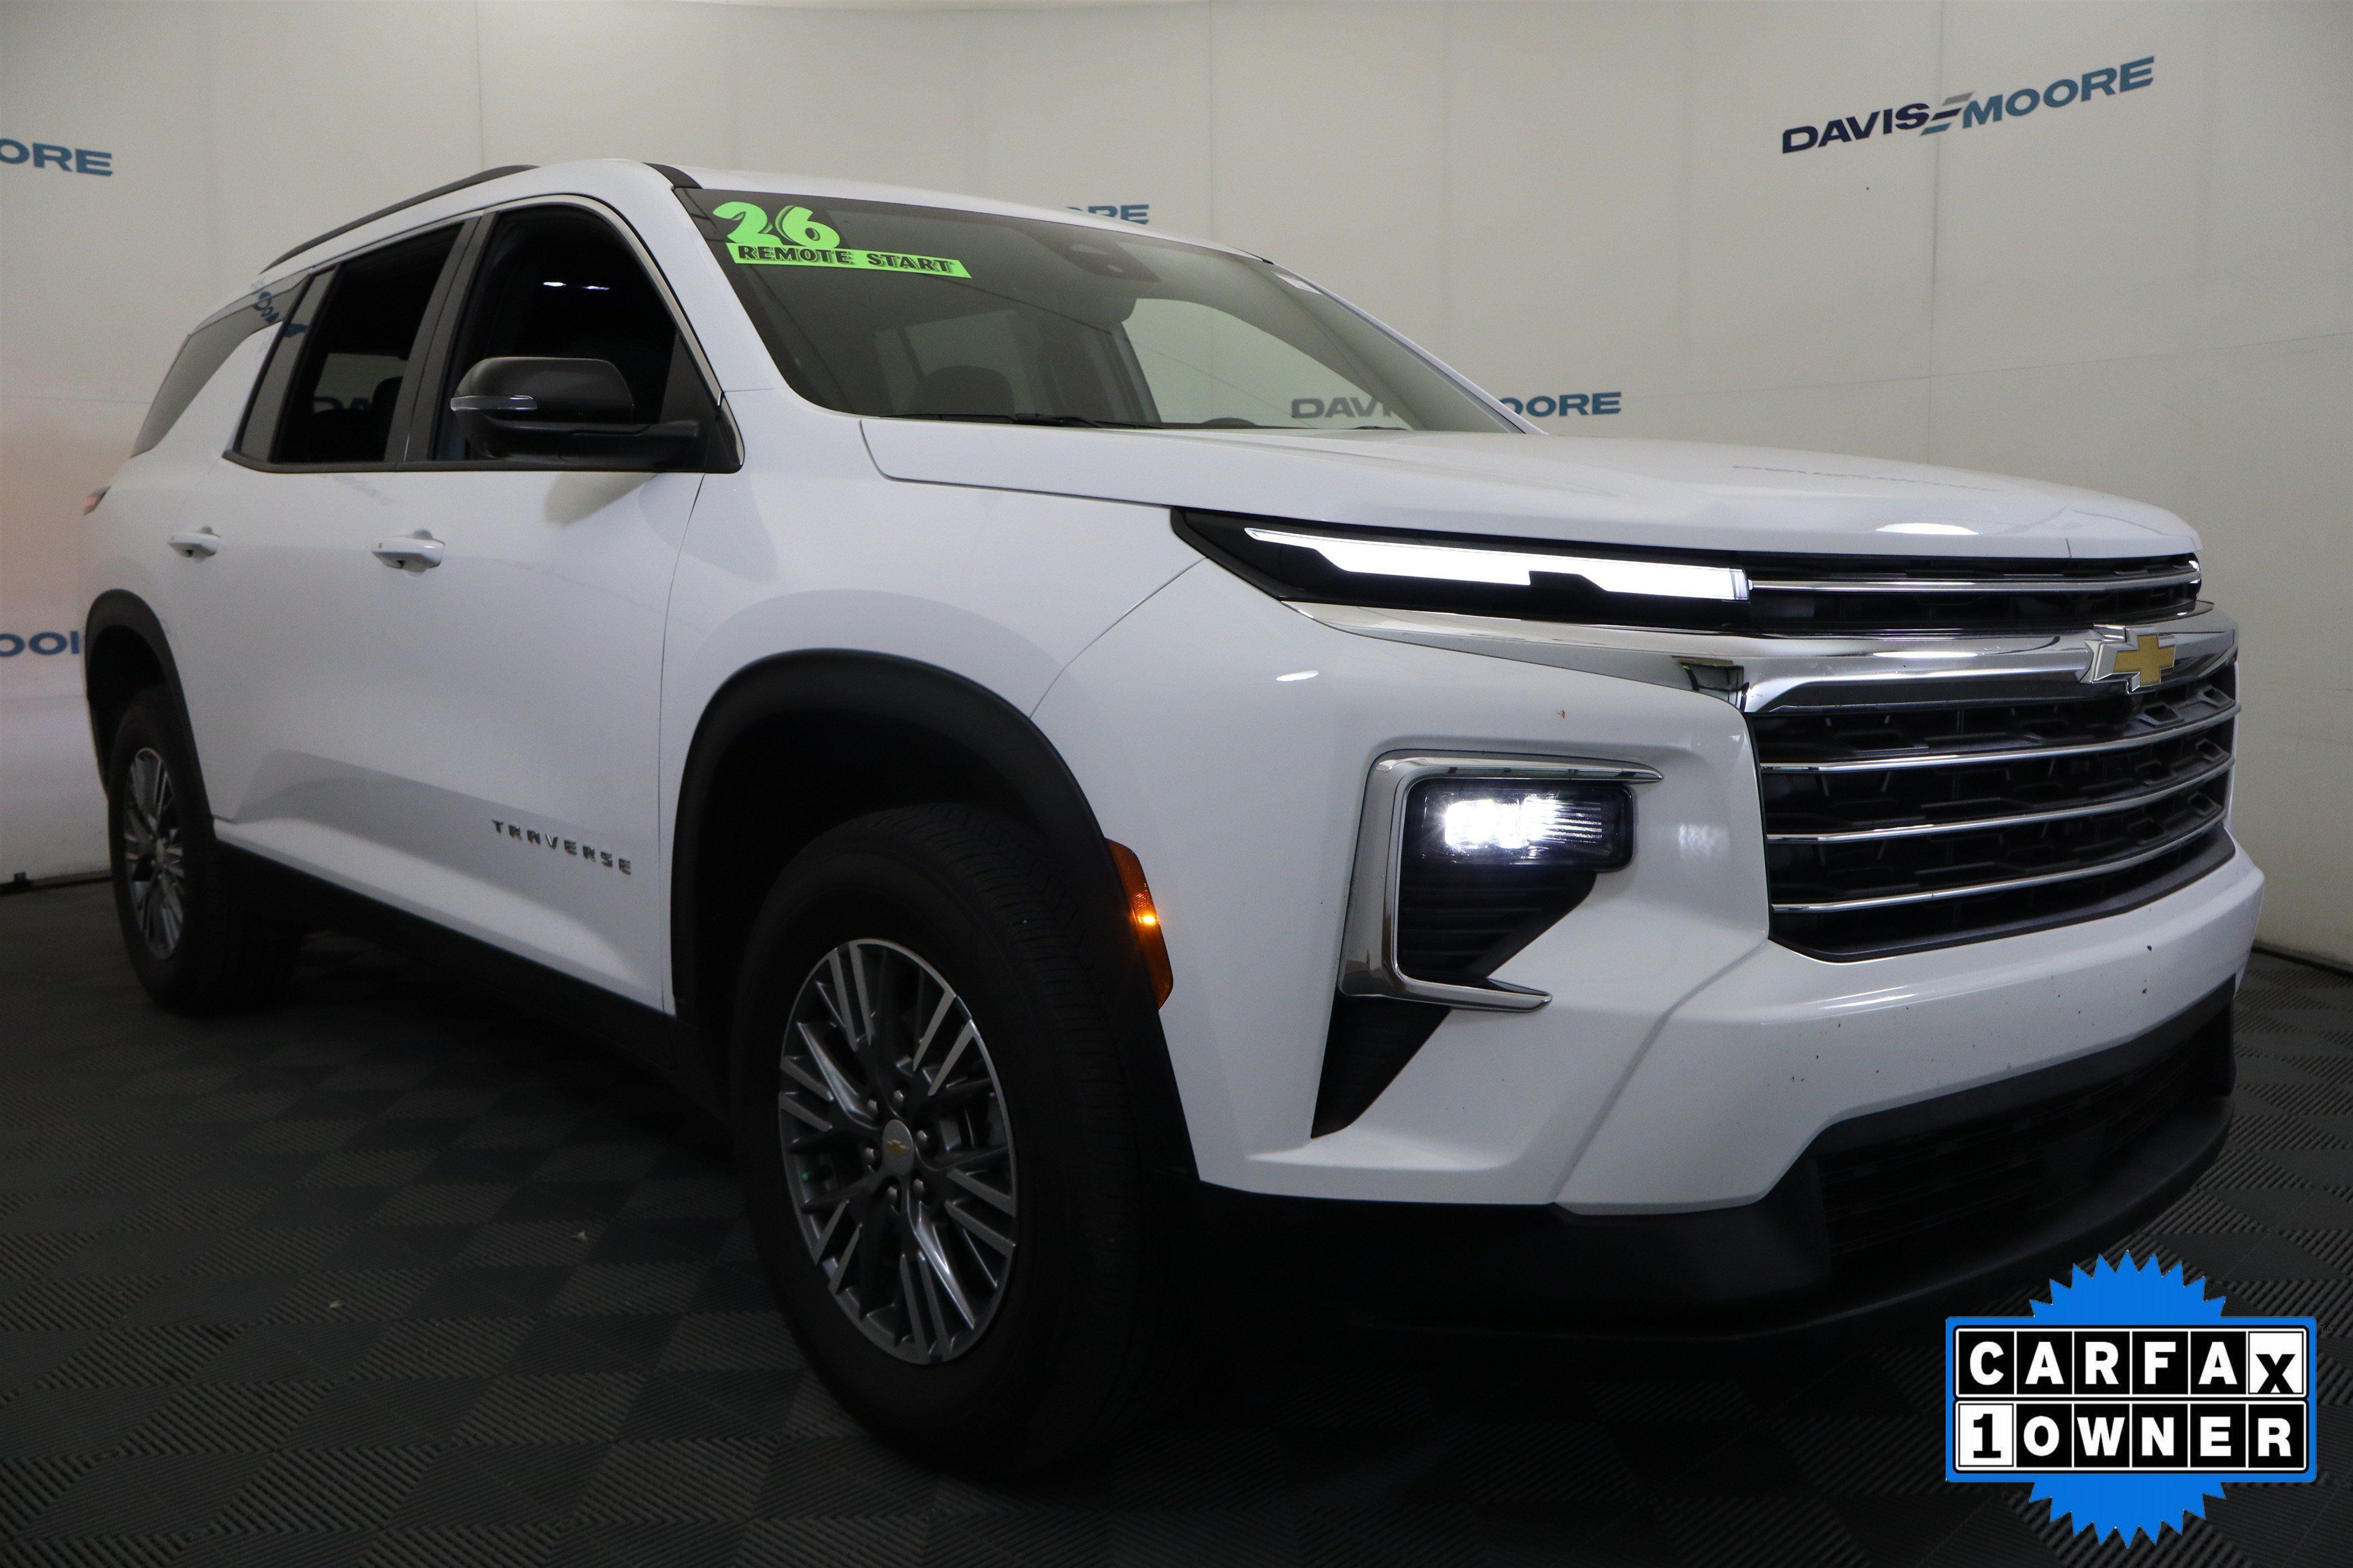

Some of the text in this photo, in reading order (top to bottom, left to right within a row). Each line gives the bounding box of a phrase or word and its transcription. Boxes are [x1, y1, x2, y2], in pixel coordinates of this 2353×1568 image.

[1782, 56, 2155, 153] DAVIS MOORE
[0, 138, 113, 177] ORE
[712, 201, 840, 248] 26
[738, 245, 951, 273] REMOTE START
[491, 819, 631, 875] TRAVERSE
